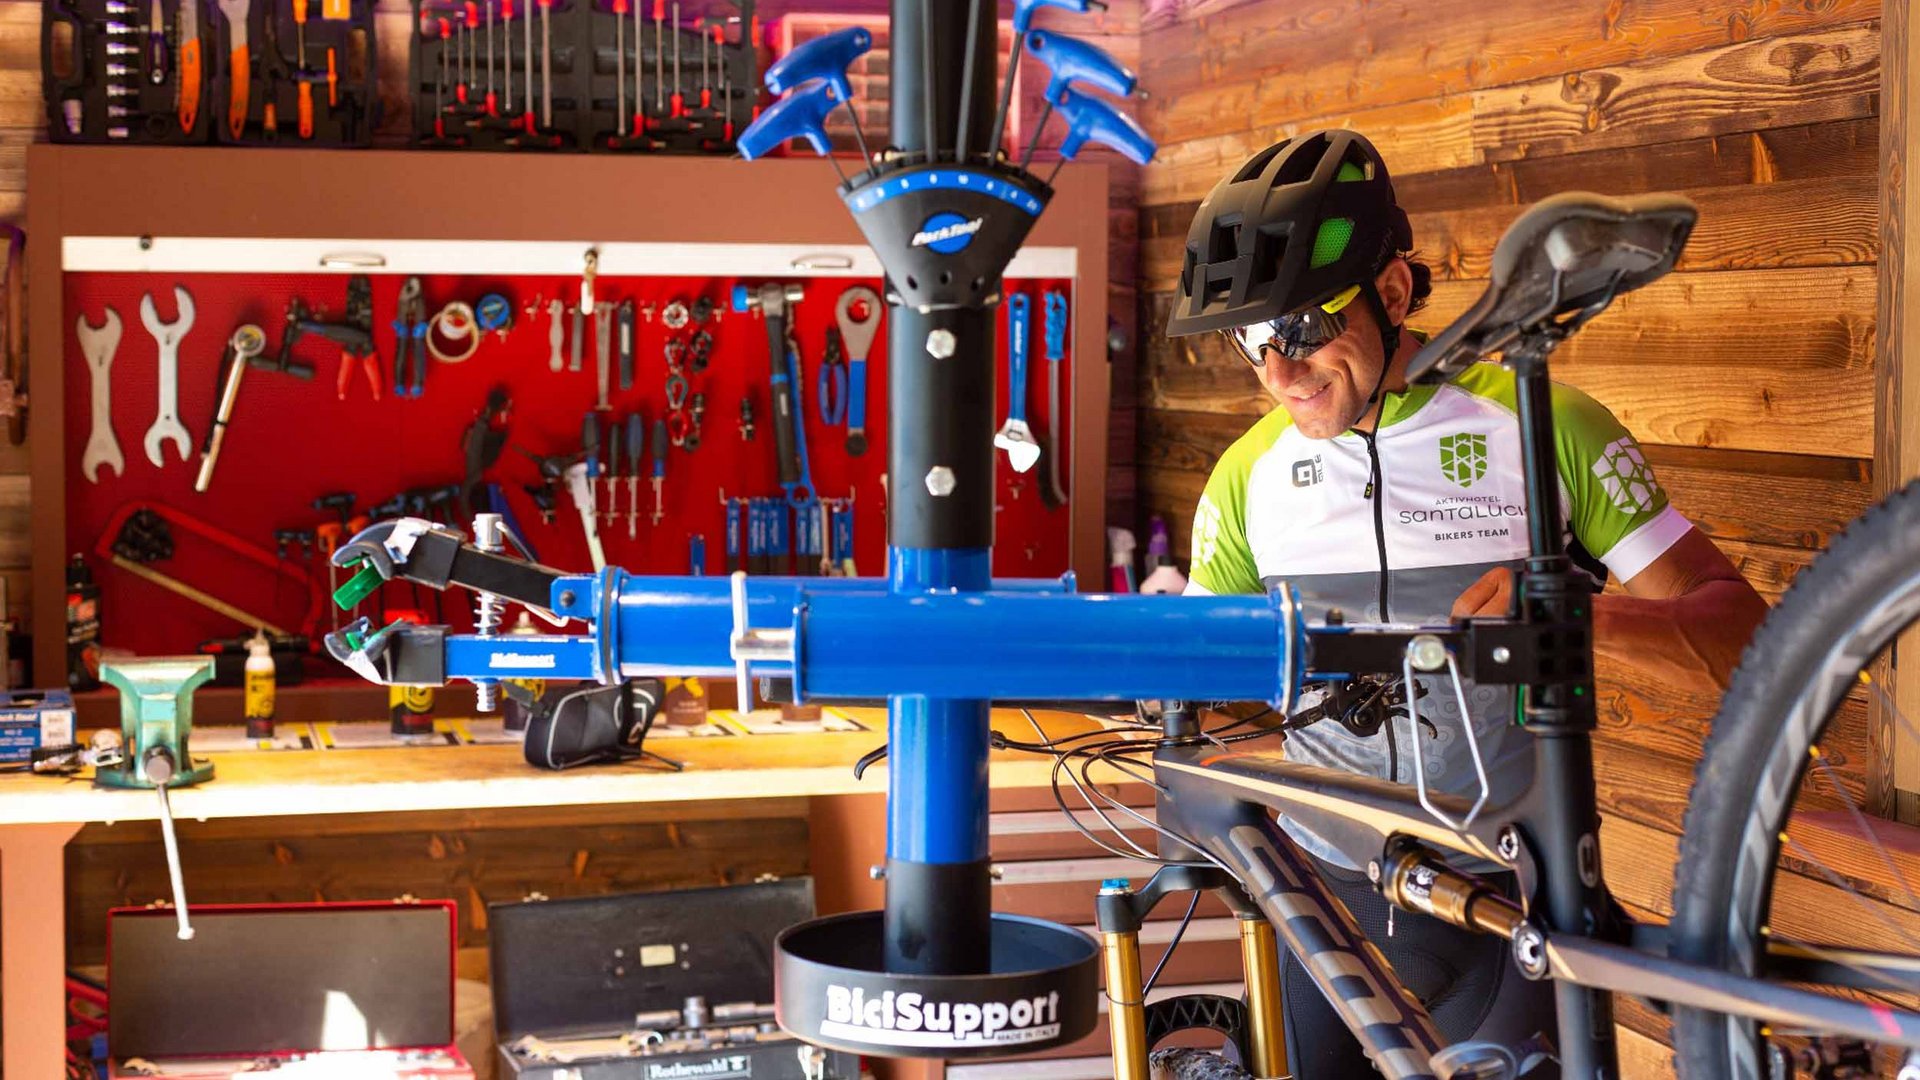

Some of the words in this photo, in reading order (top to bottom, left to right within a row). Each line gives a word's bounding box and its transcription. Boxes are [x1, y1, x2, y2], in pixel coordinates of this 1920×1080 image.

[912, 217, 983, 246] ParkTool
[1435, 495, 1501, 505] AKTIVHOTEL
[1435, 531, 1473, 541] BIKERS
[1478, 528, 1509, 538] TEAM
[1211, 825, 1437, 1080] SCOT
[826, 984, 1059, 1040] BiciSupport
